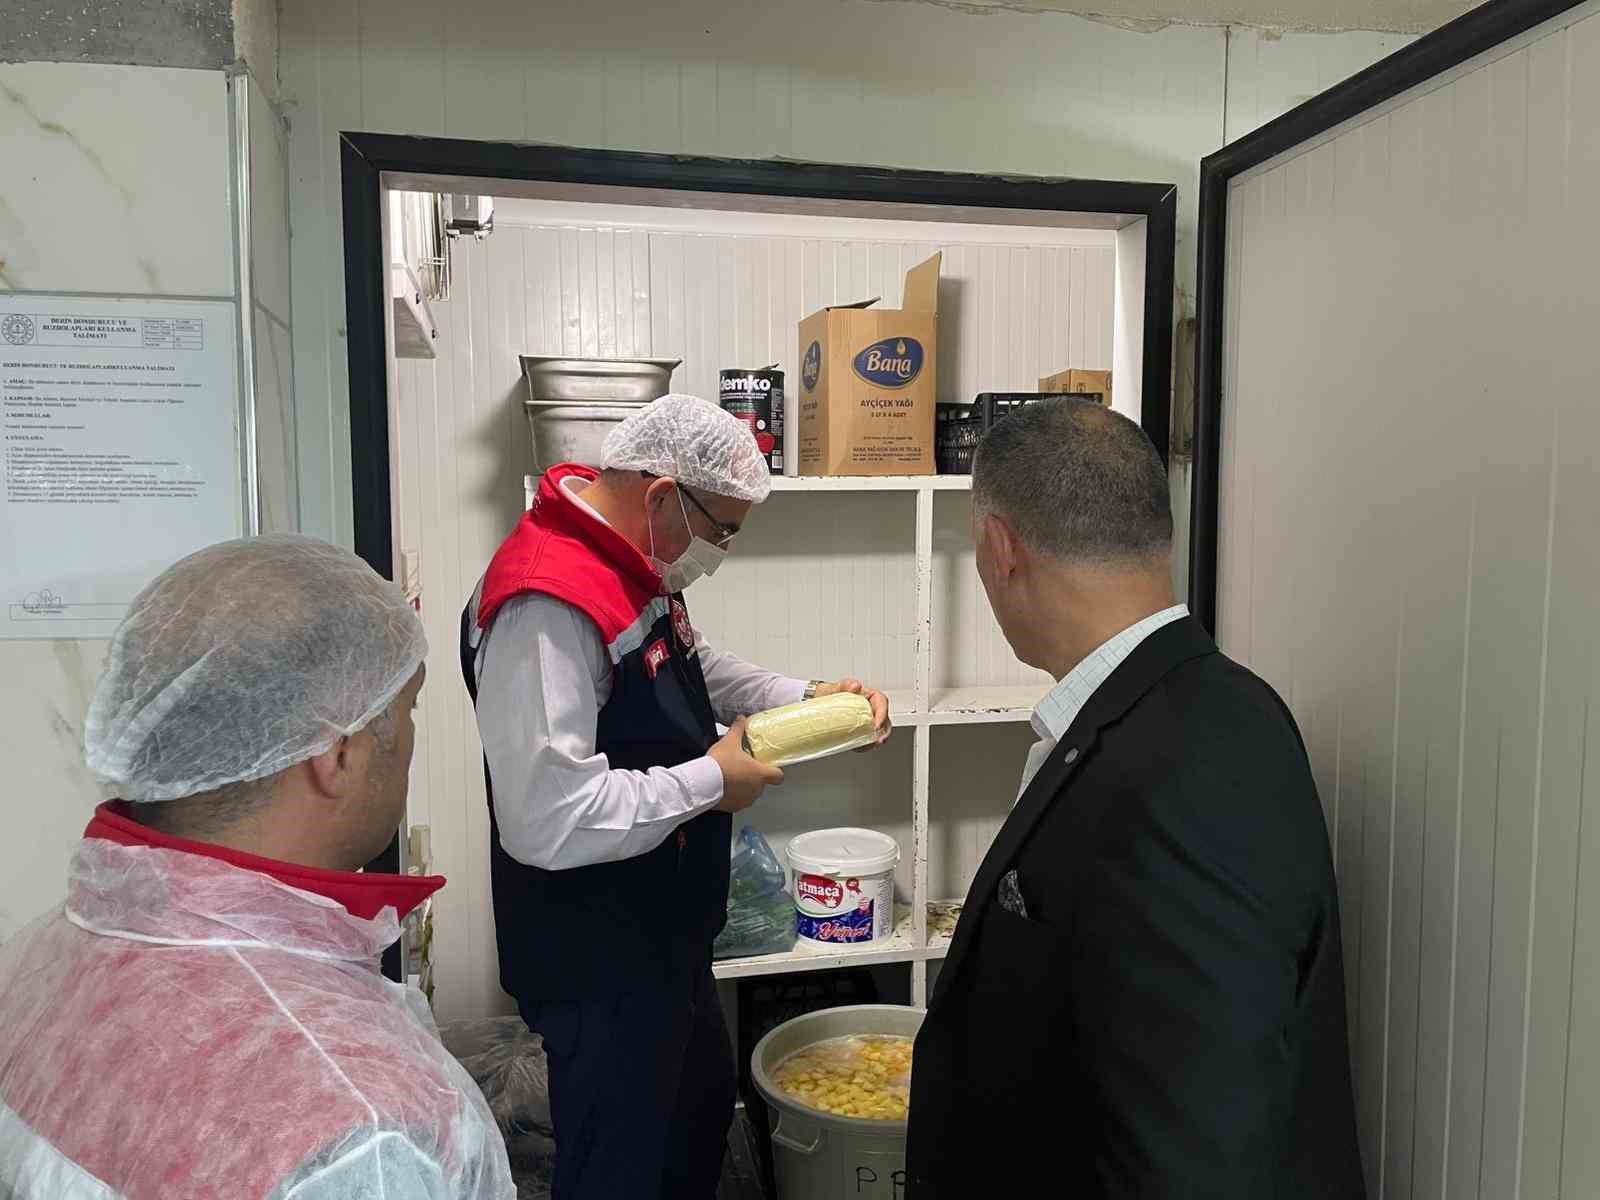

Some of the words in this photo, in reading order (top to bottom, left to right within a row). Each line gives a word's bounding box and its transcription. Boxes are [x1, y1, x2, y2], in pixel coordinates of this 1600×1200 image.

[866, 350, 912, 378] Bana
[860, 398, 894, 409] AYÇİÇEK
[895, 397, 914, 408] YAĞI
